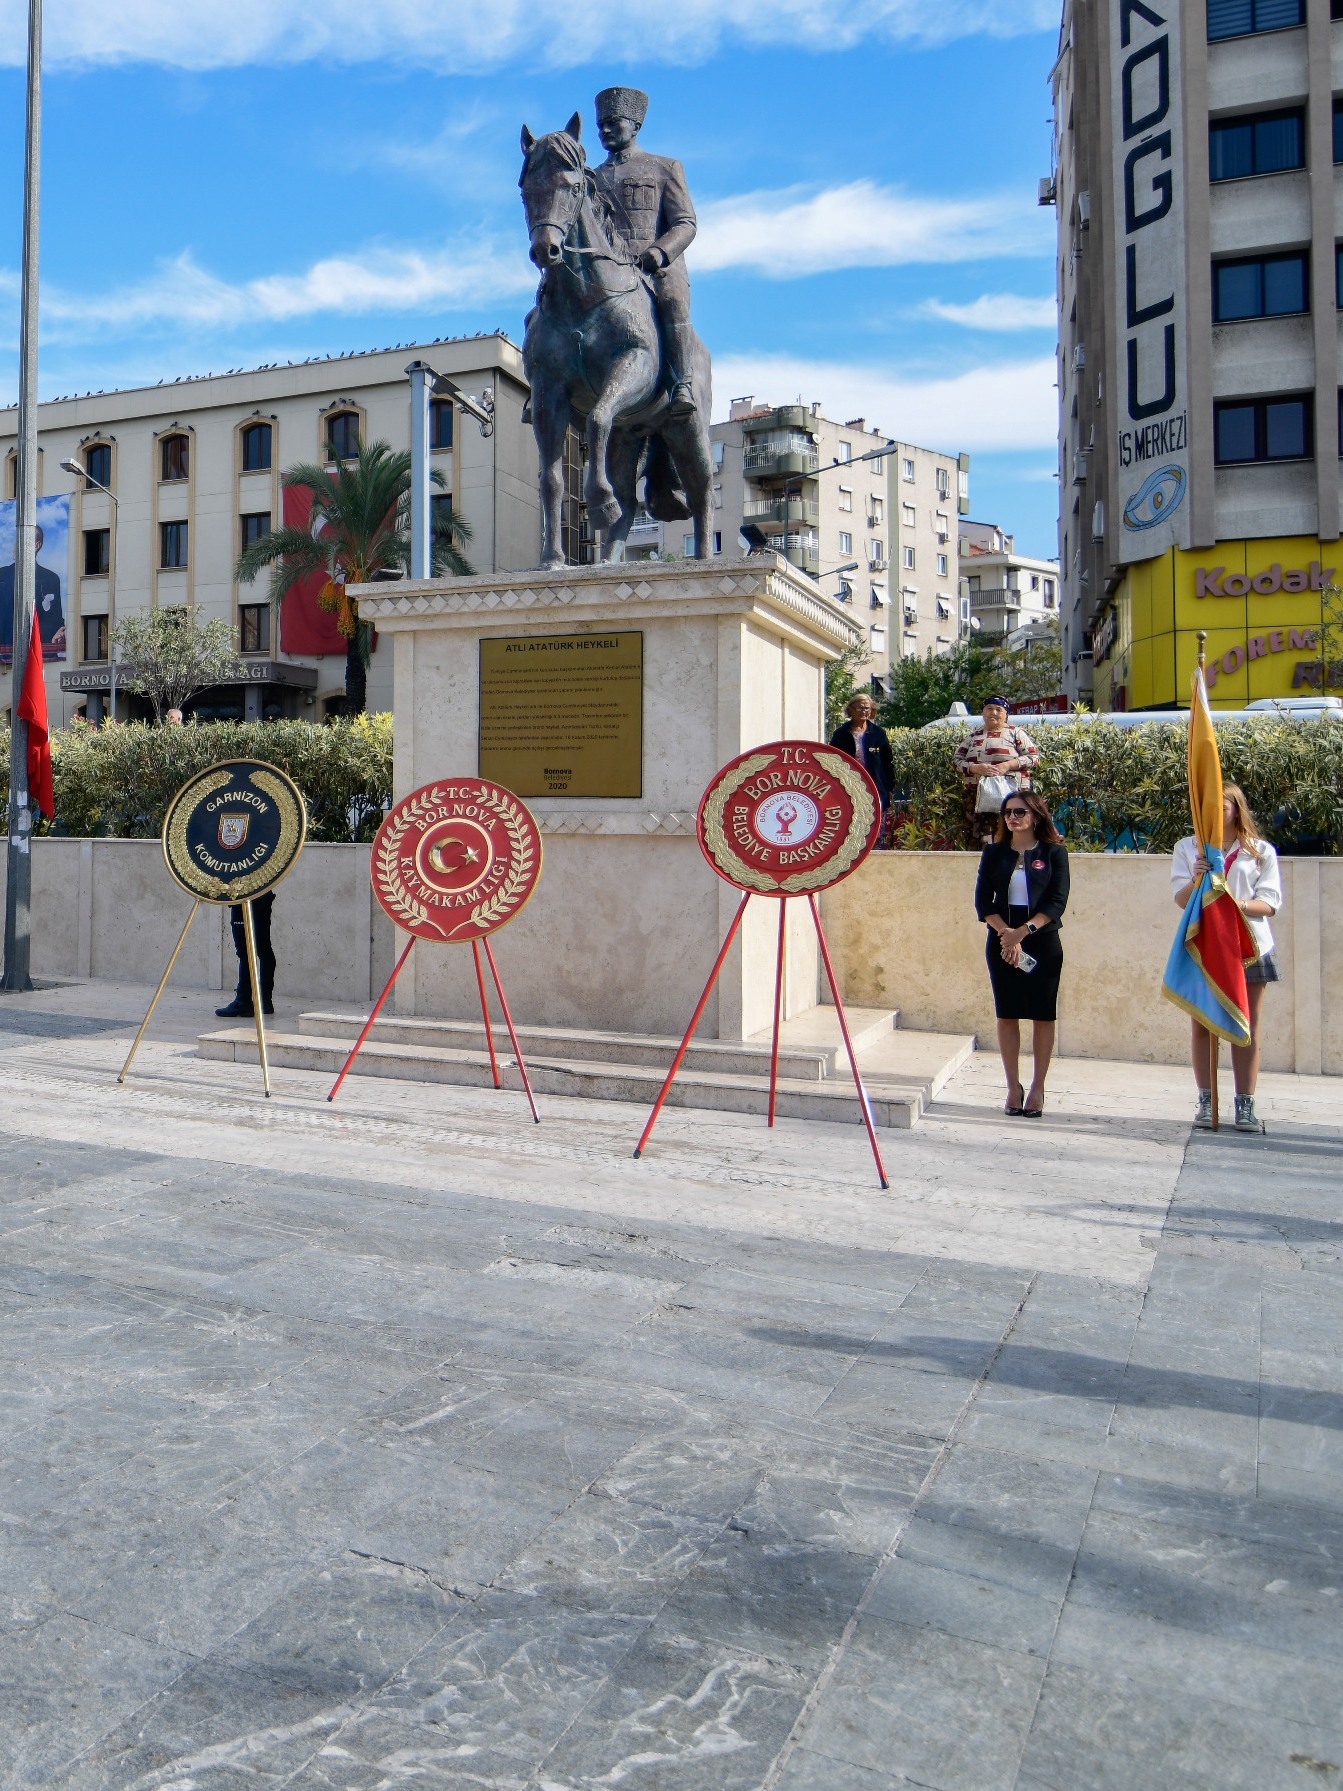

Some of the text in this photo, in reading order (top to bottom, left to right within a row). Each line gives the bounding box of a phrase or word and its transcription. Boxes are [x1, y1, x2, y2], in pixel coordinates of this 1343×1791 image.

[1119, 409, 1187, 467] İŞ MERKEZİ
[1195, 561, 1337, 598] Kodak
[505, 638, 619, 653] ATLI ATATÜRK HEYKELİ
[781, 747, 810, 764] T.C.
[446, 787, 472, 799] T.C.
[548, 782, 568, 790] 2020
[743, 769, 832, 800] BORNOVA
[206, 790, 269, 814] GARNİZON
[760, 795, 785, 823] BORNOVA
[414, 803, 497, 832] BORNOVA
[733, 805, 842, 865] BELEDİYE BAŞKANLIĞI
[400, 856, 508, 908] KAYMAKAMLIĞI
